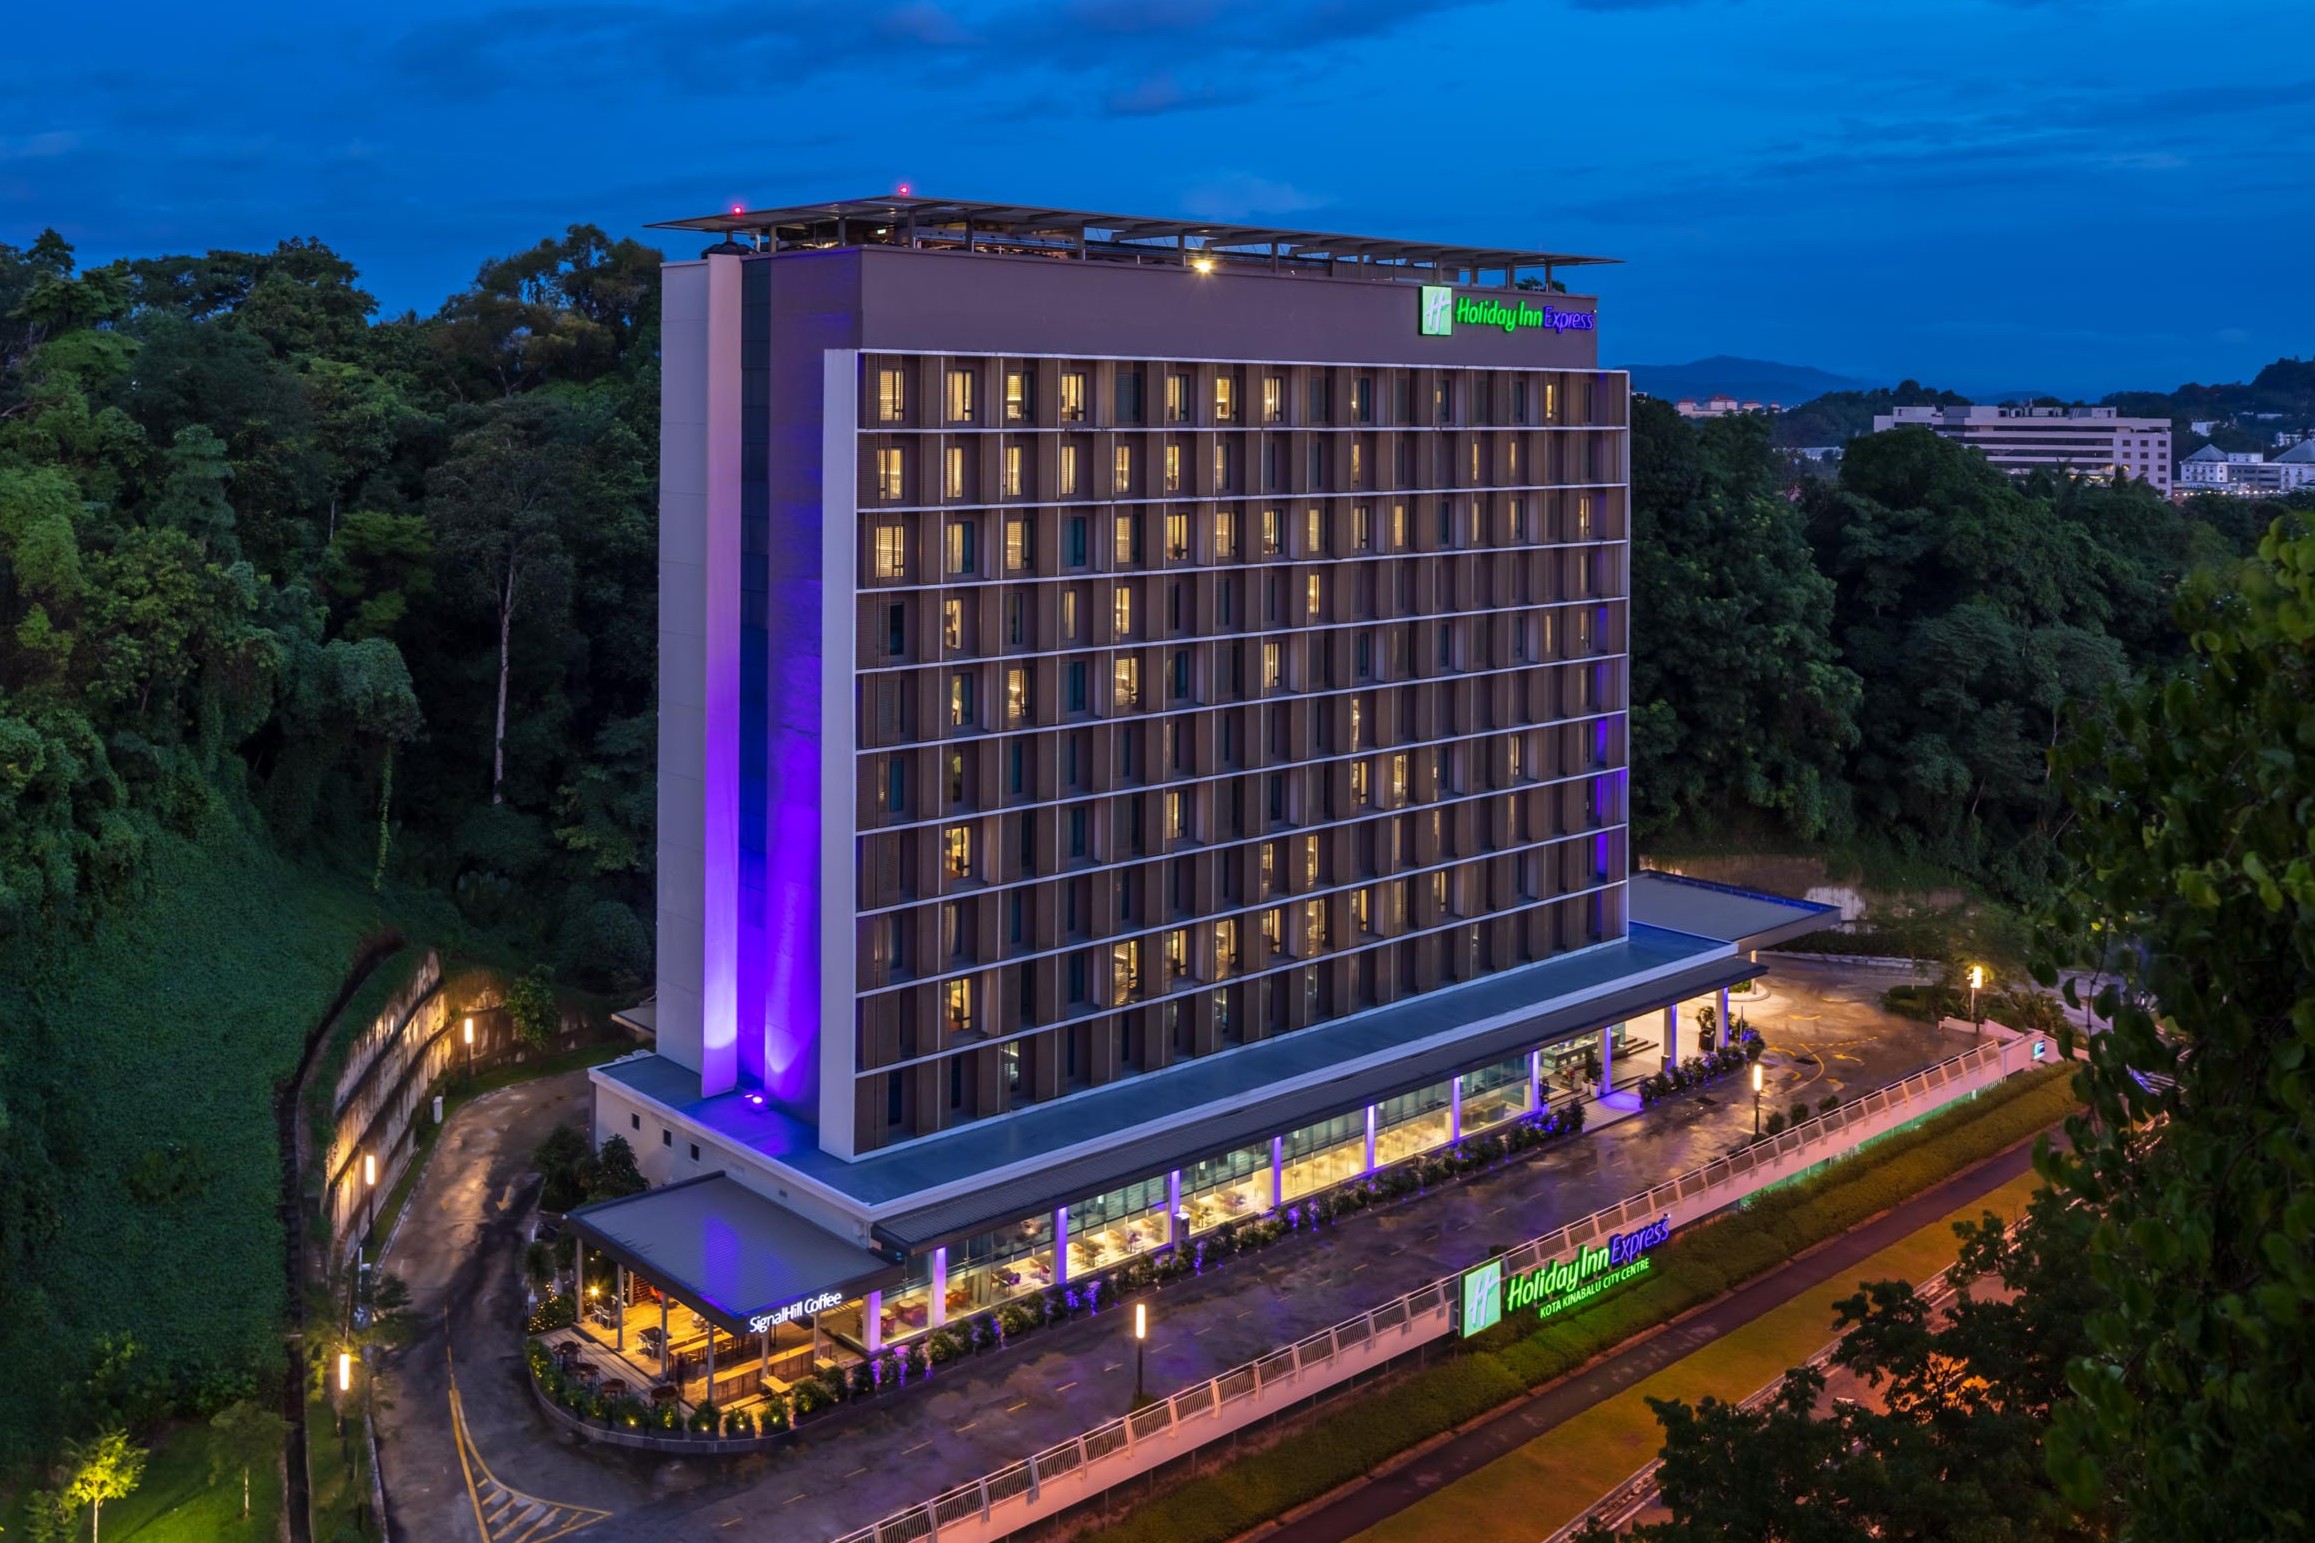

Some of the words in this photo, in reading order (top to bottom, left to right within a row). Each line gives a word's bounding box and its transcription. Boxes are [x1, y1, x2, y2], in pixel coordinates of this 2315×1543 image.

[1456, 298, 1516, 332] Holiday
[1518, 300, 1543, 327] Inn
[1544, 306, 1594, 332] Express
[1507, 1260, 1580, 1312] Holiday
[1580, 1246, 1609, 1279] Inn
[1611, 1219, 1670, 1263] Express
[1540, 1303, 1562, 1319] KOTA
[1562, 1280, 1602, 1308] KINABALU
[1603, 1271, 1623, 1289] CITY
[1621, 1257, 1650, 1280] CENTRE
[750, 1301, 803, 1332] SignalHill
[804, 1292, 842, 1314] Coffee
